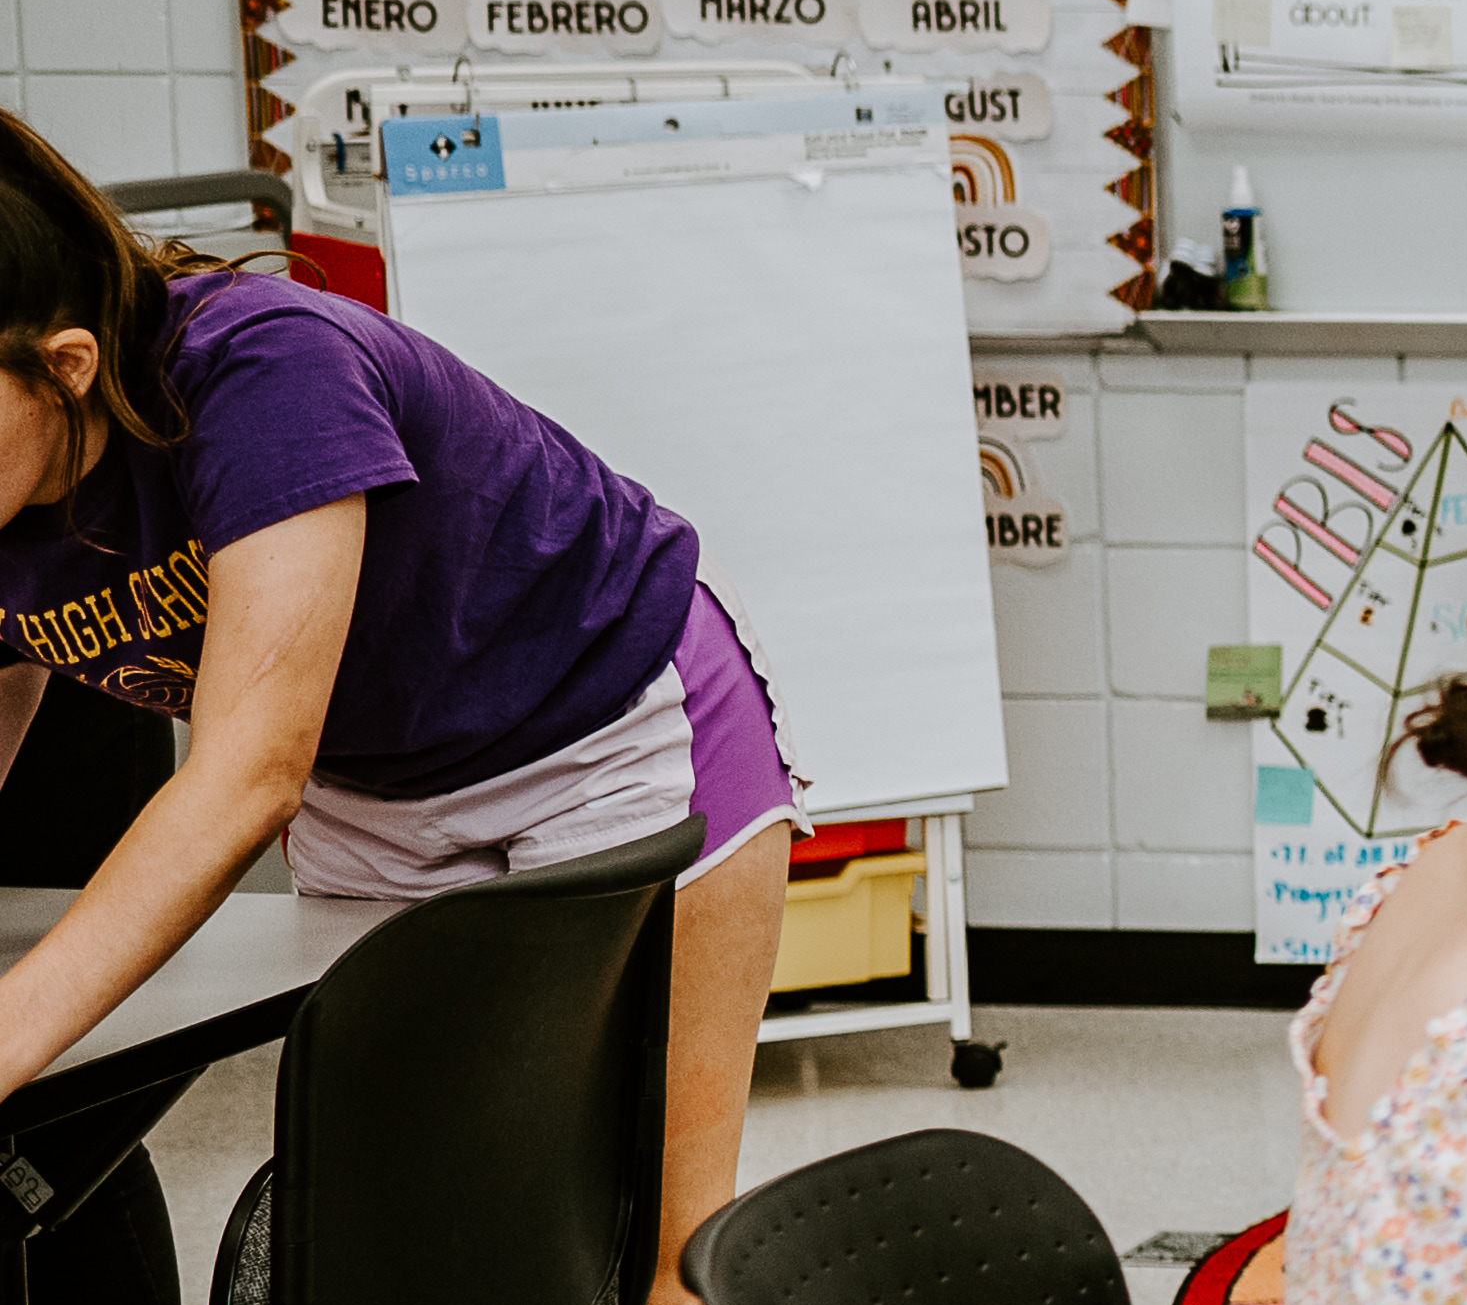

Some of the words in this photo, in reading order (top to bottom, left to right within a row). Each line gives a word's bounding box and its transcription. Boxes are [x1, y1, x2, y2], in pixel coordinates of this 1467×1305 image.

[487, 0, 650, 34] FEBRERO
[1253, 398, 1412, 611] PBIS
[16, 587, 132, 664] HIGH
[129, 538, 208, 640] SCHO
